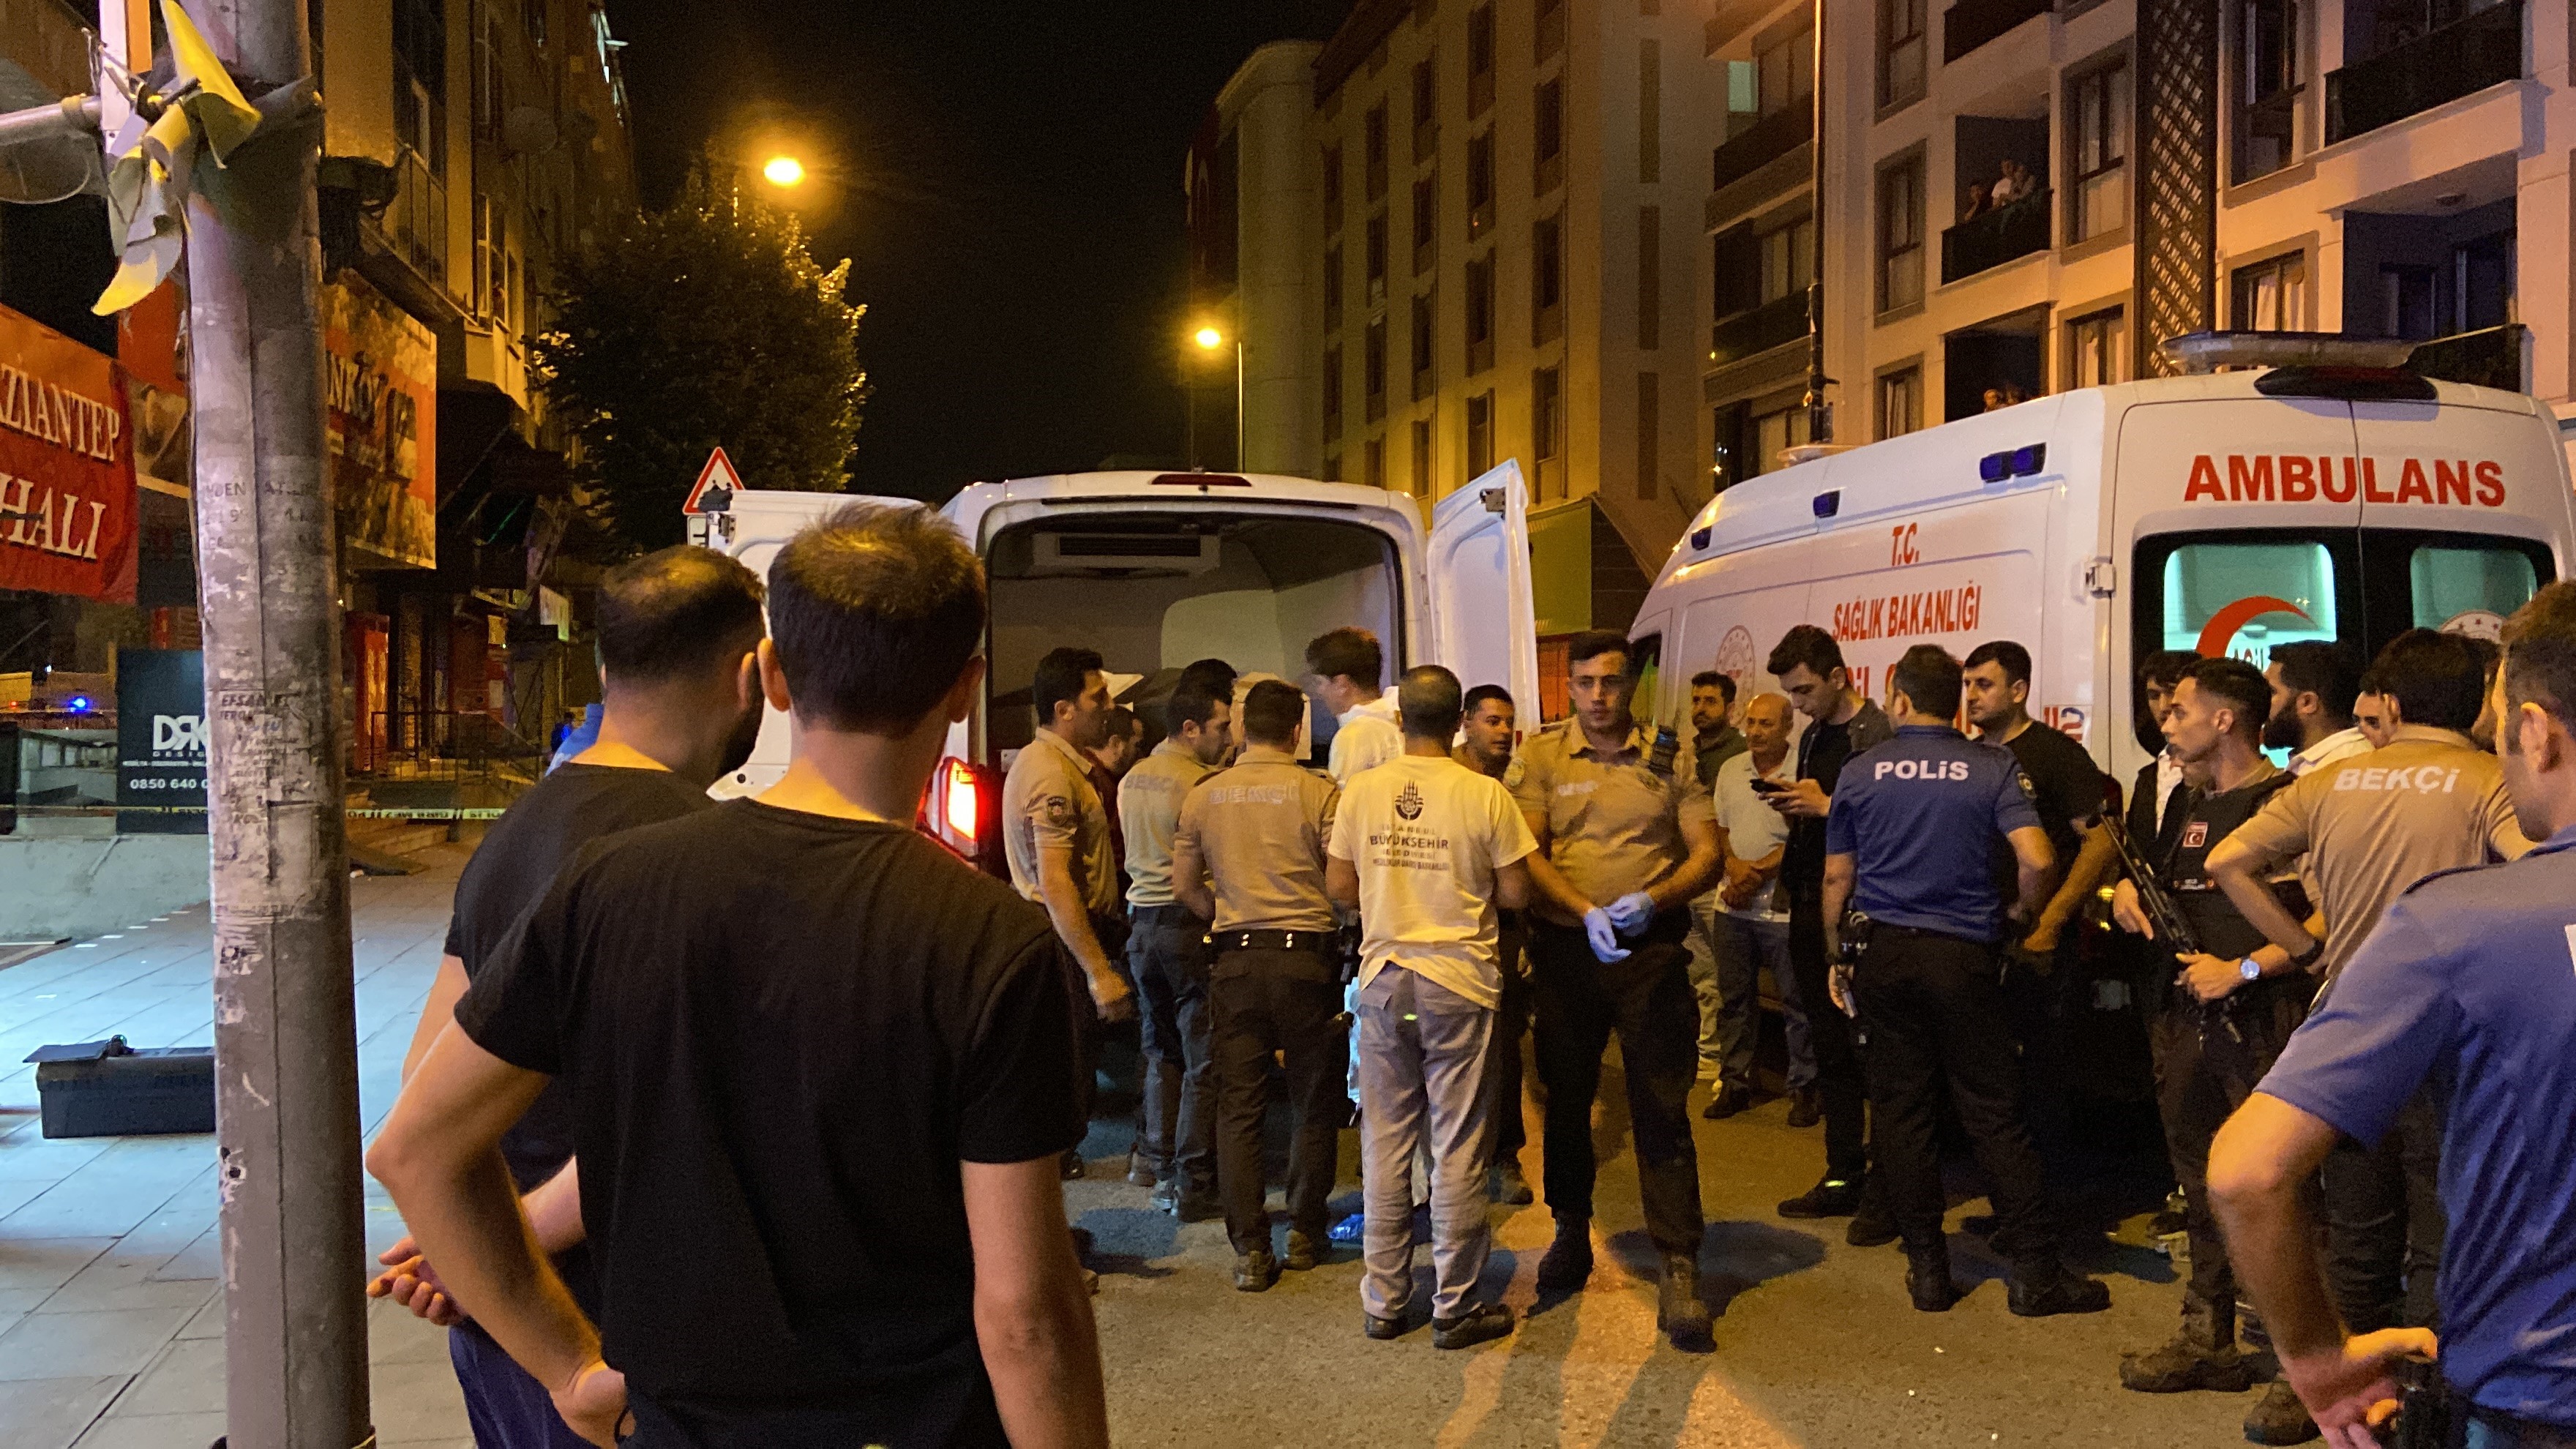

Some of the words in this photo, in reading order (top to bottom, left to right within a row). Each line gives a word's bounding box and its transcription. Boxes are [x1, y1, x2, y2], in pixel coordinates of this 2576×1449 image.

[2184, 454, 2506, 507] AMBULANS
[1892, 522, 1920, 566] T.C.
[1832, 595, 1885, 642] SAĞLIK
[1887, 580, 1982, 637] BAKANLIĞI
[130, 779, 166, 789] 0850
[170, 779, 197, 789] 640
[2334, 765, 2461, 795] BEKÇİ
